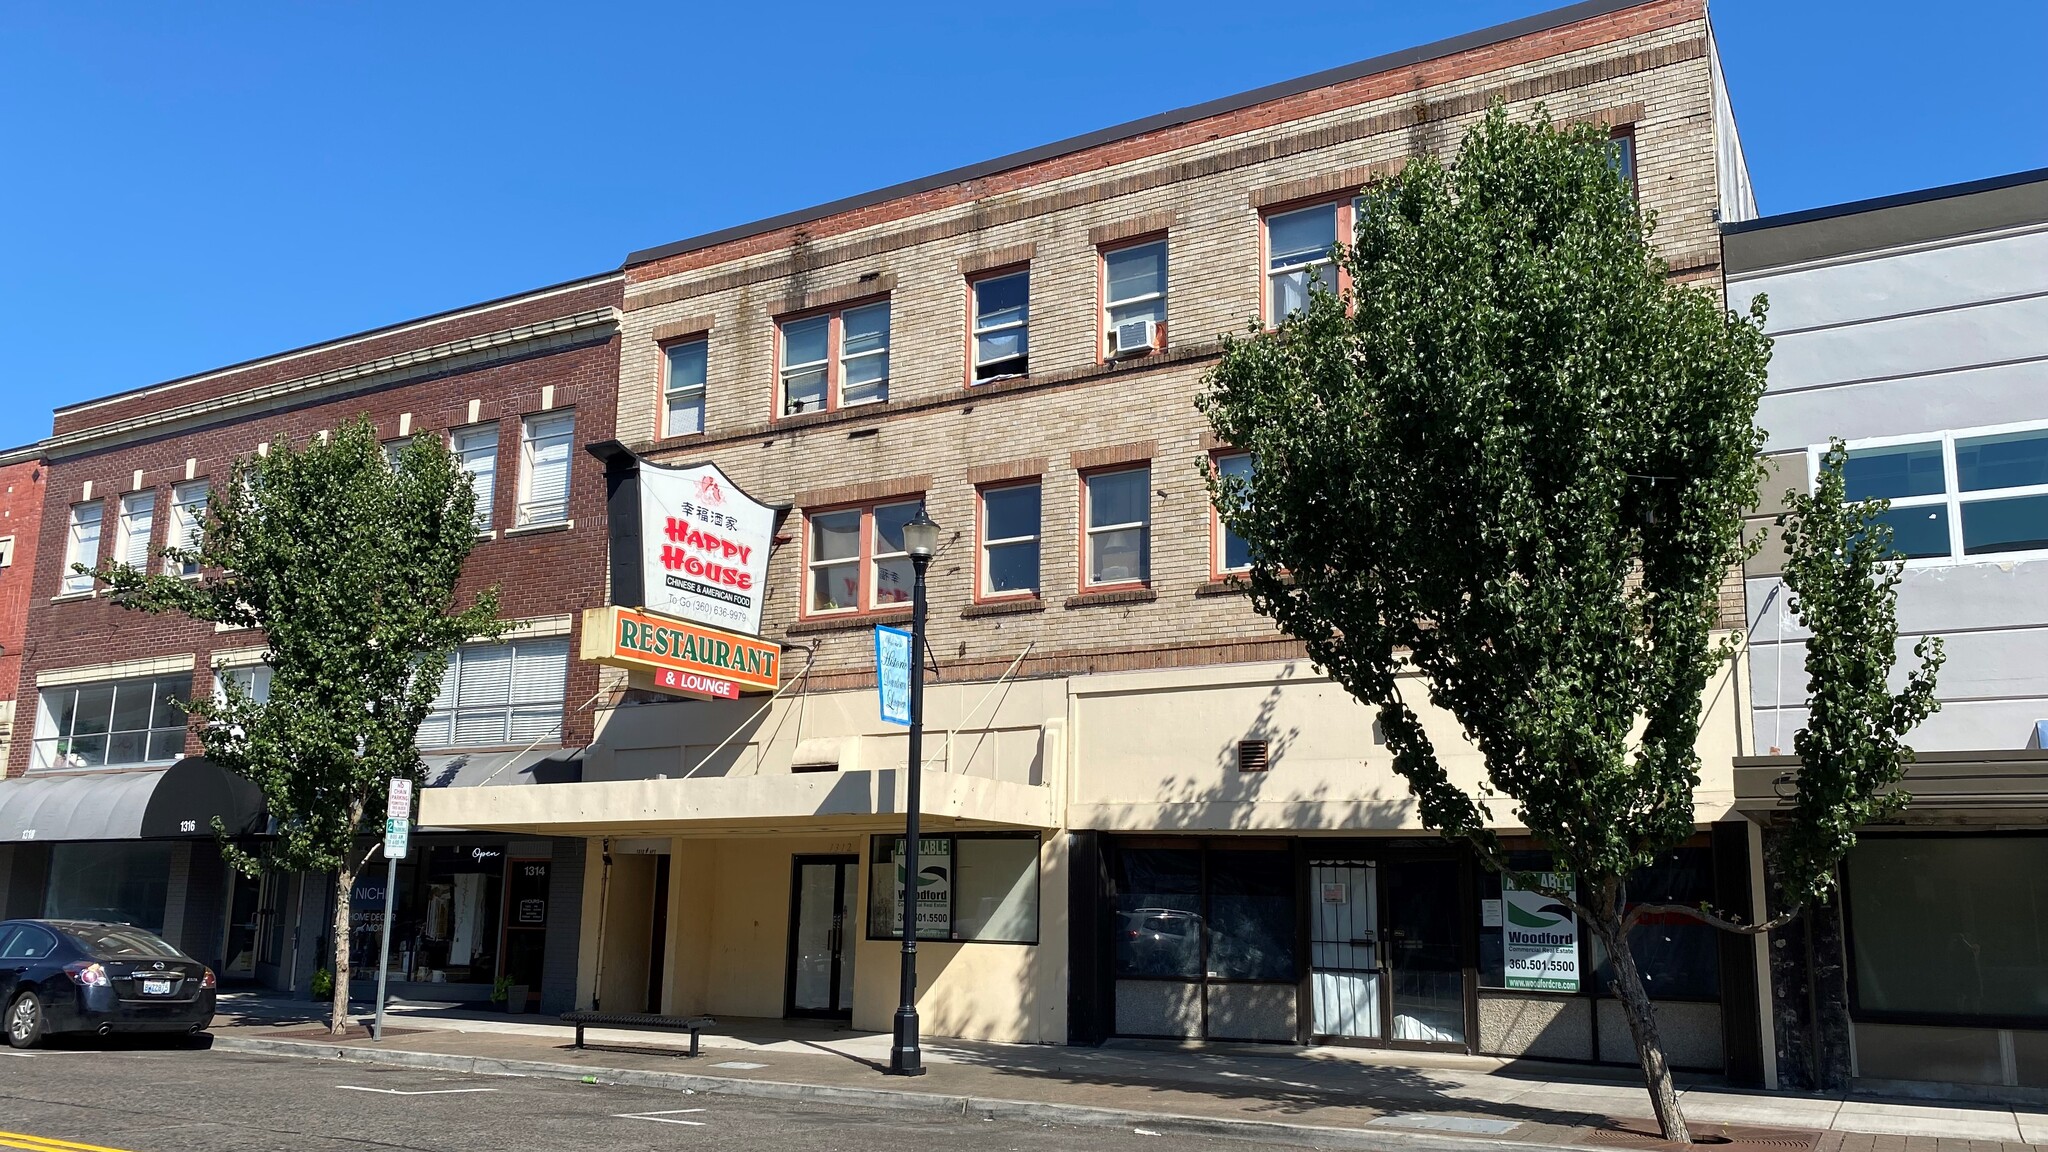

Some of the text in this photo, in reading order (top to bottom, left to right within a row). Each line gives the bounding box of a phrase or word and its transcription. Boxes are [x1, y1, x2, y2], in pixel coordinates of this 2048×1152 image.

[681, 501, 738, 532] 幸福酒家
[664, 517, 752, 565] HAPPY
[660, 545, 753, 591] HOUSE
[667, 577, 750, 607] CHINESE & AMERICAN FOOD
[668, 593, 747, 623] To Go (360) 636-9979
[620, 619, 775, 677] RESTAURANT
[665, 671, 731, 696] & LOUNGE
[180, 820, 196, 832] 1316
[387, 821, 394, 832] 2
[898, 840, 948, 855] ALABLE
[471, 847, 500, 864] Open
[524, 866, 546, 876] 1314
[1506, 873, 1572, 891] AABLE
[355, 887, 387, 900] NICH
[371, 913, 397, 922] DECR
[366, 924, 385, 932] MOR
[1508, 931, 1573, 945] Woodford
[1508, 945, 1541, 953] Commercial
[1556, 947, 1574, 955] Estate
[1509, 958, 1575, 972] 360.501.5500
[1508, 978, 1577, 989] www.woodfordcre.com
